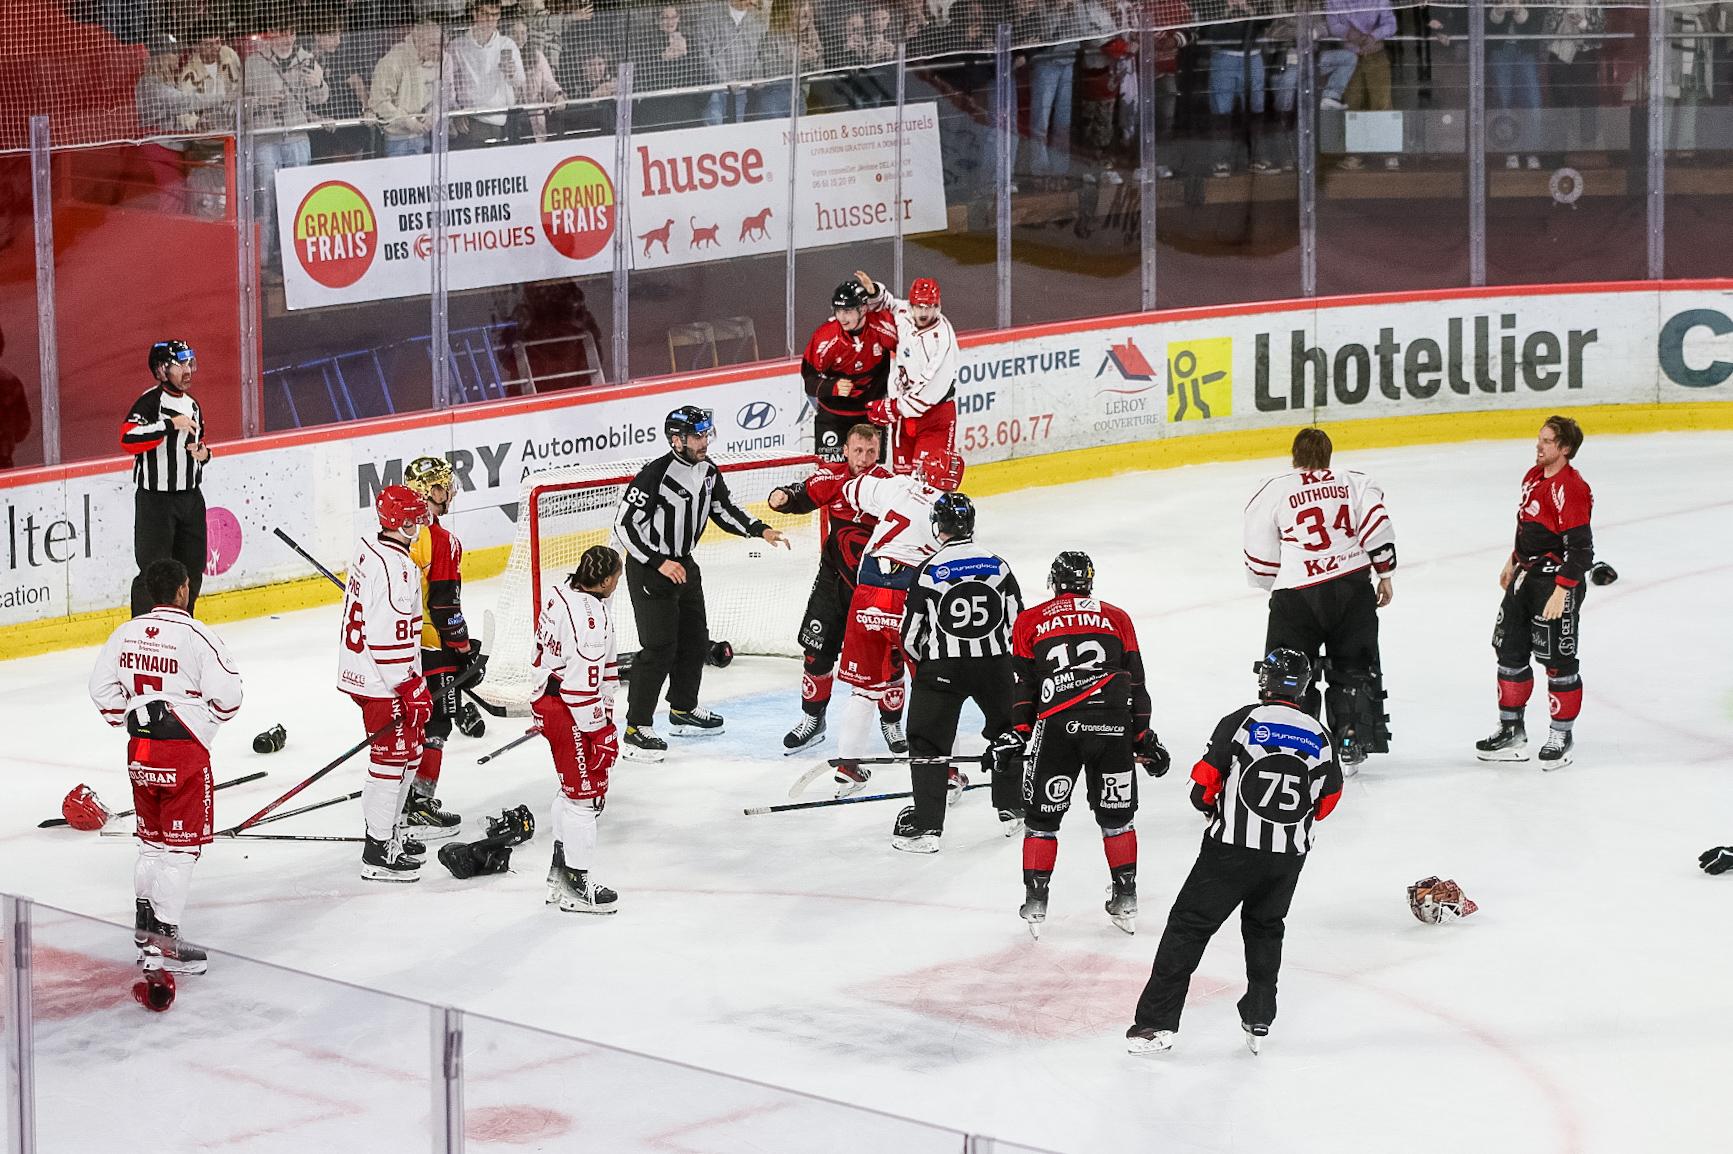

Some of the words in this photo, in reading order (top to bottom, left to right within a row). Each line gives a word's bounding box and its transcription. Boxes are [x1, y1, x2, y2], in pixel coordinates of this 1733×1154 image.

[840, 125, 849, 139] &
[852, 121, 884, 138] soins
[637, 146, 764, 197] husse
[476, 176, 529, 198] OFFICIEL
[551, 183, 606, 210] GRAND
[305, 209, 366, 237] GRAND
[399, 212, 423, 232] DES
[475, 203, 511, 223] FRAIS
[550, 205, 608, 235] FRAIS
[306, 231, 368, 263] FRAIS
[384, 241, 409, 261] DES
[956, 349, 1080, 385] OUVERTURE
[1255, 314, 1598, 412] Lhotellier
[1106, 398, 1148, 416] LEROY
[1094, 413, 1159, 432] COUVERTURE
[727, 434, 785, 453] HYUNDAI
[358, 442, 513, 508] MRY
[521, 423, 657, 462] Automobiles
[1300, 470, 1335, 486] K2
[627, 486, 650, 507] 85
[1295, 504, 1356, 552] 34
[1304, 555, 1340, 577] K2
[0, 585, 50, 609] ation
[949, 595, 989, 629] 95
[1036, 613, 1115, 637] MATIMA
[802, 633, 823, 650] TEAM
[119, 652, 179, 674] REYNAUD
[1046, 640, 1106, 673] 12
[588, 665, 599, 688] 8
[1054, 671, 1075, 686] EMI
[572, 724, 588, 778] BRIANÇON
[1271, 731, 1320, 750] synerglace
[1258, 770, 1301, 811] 75
